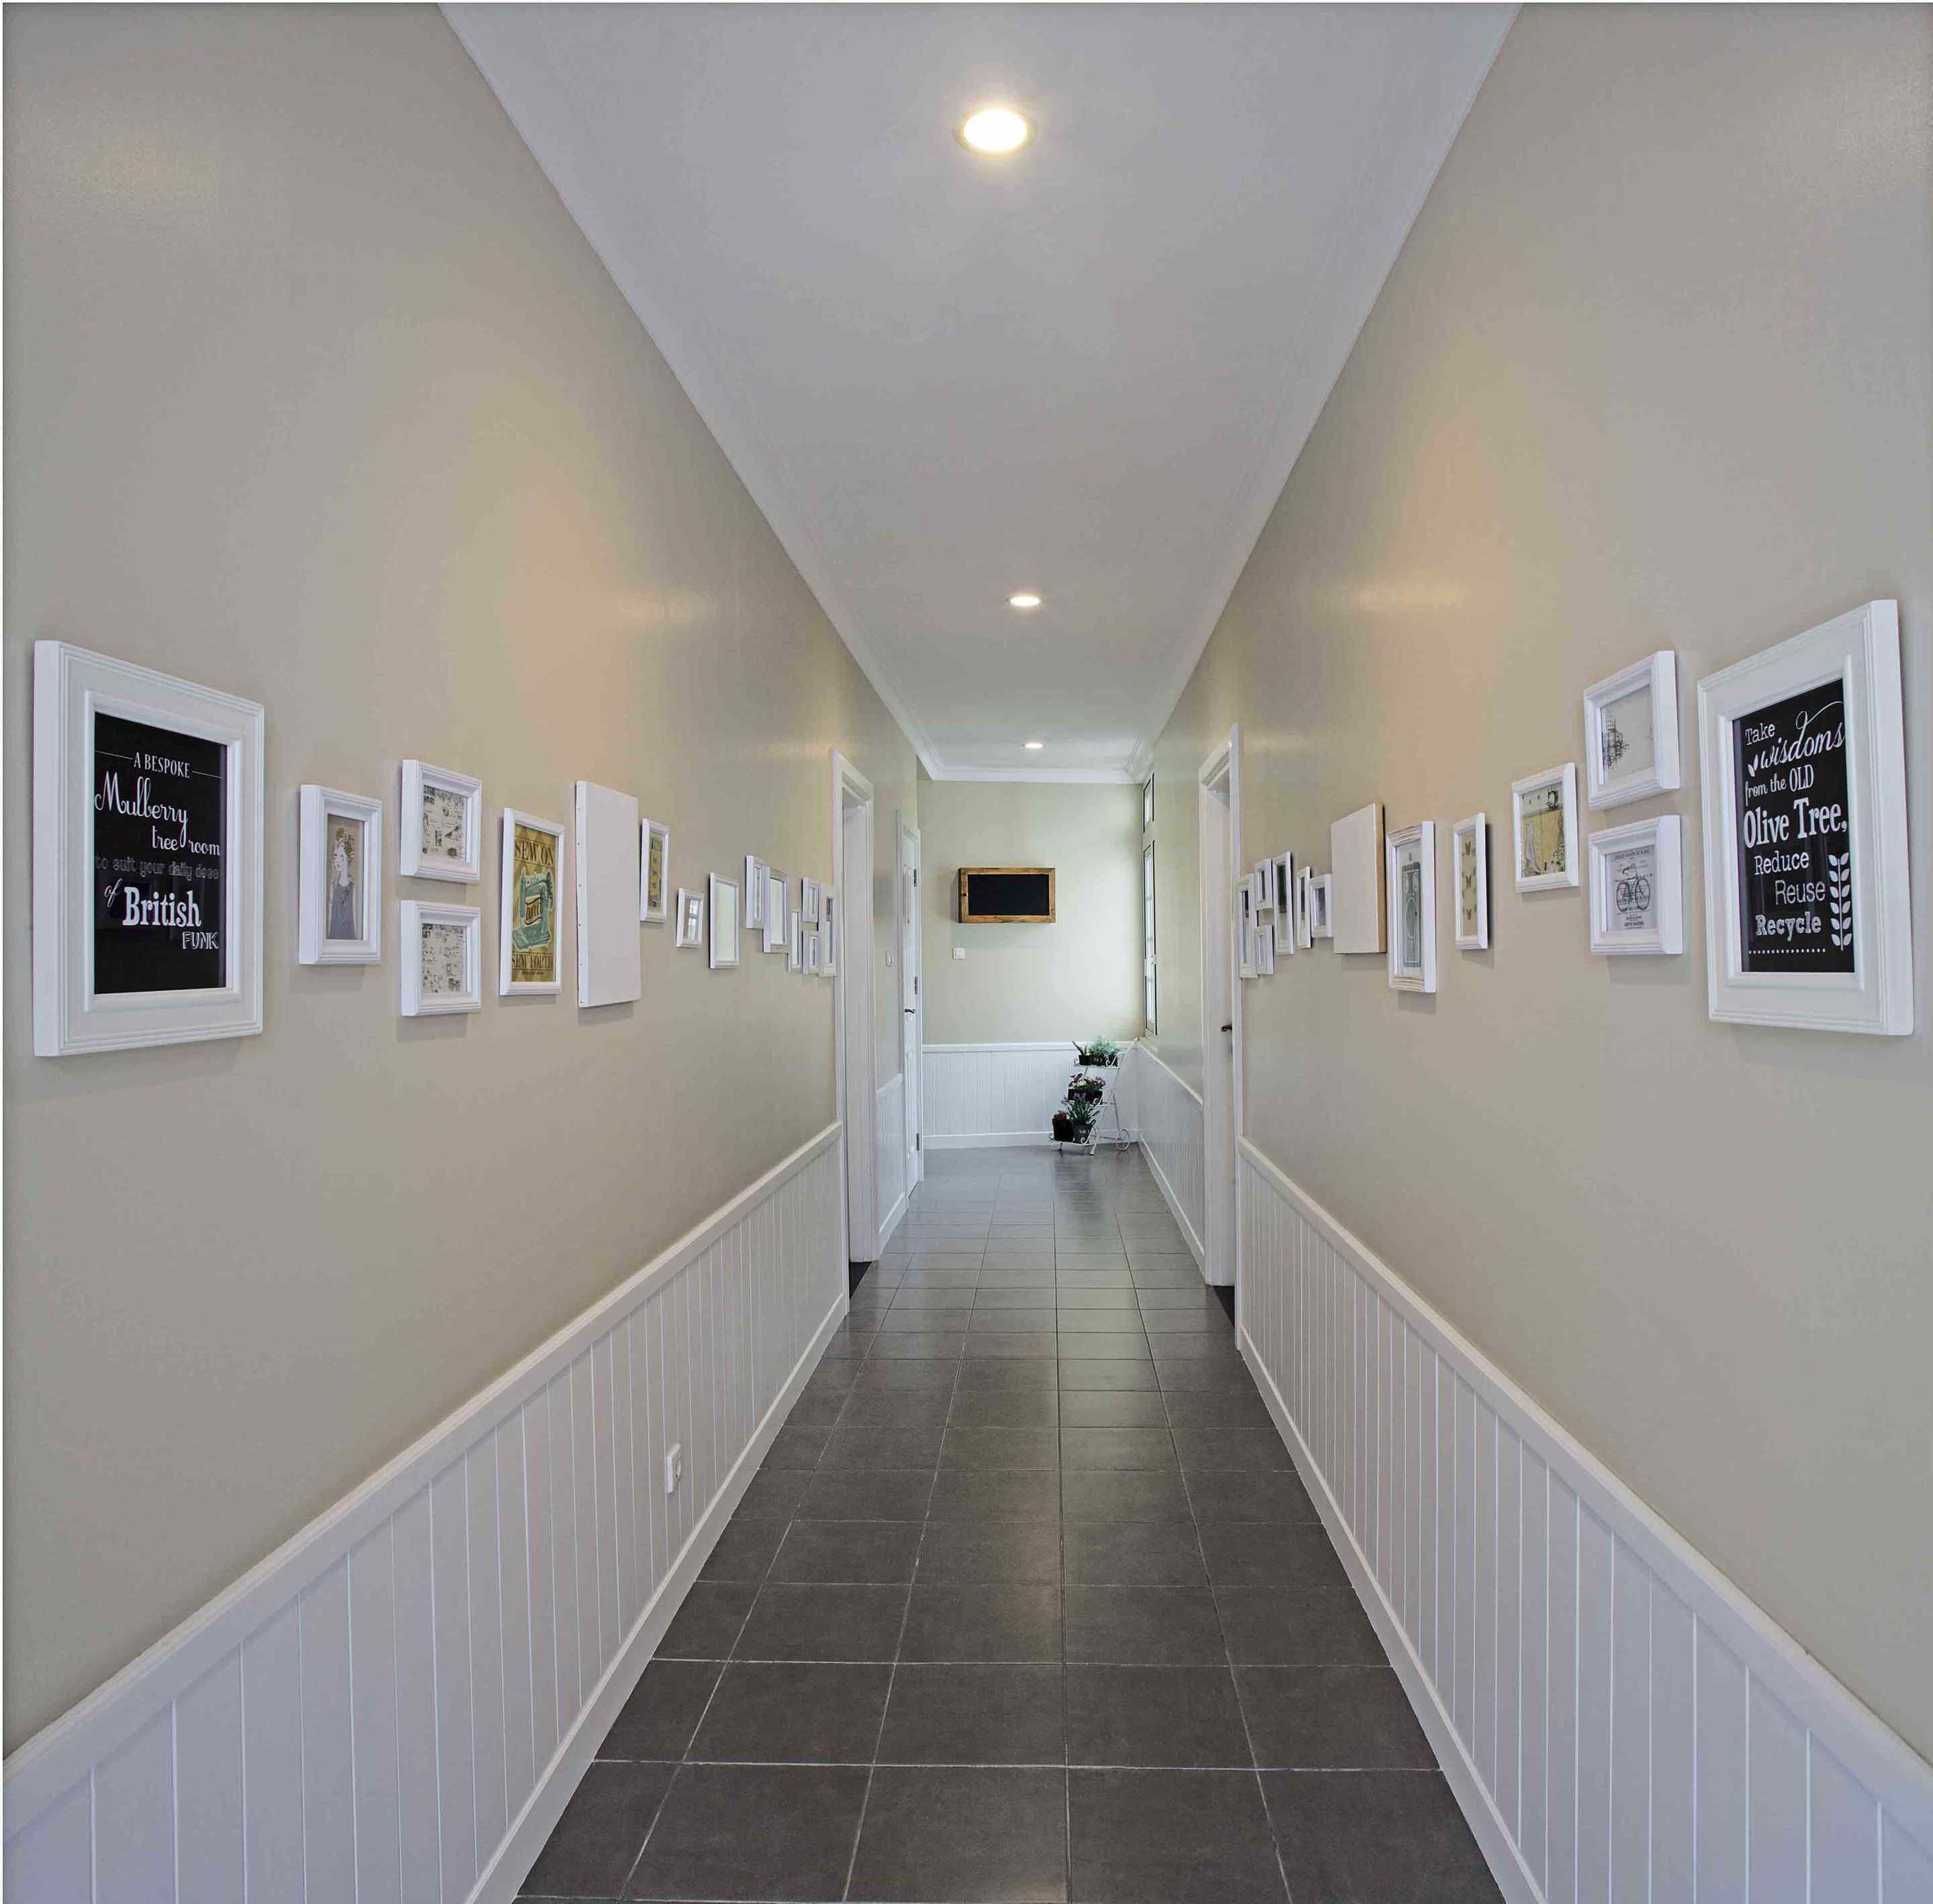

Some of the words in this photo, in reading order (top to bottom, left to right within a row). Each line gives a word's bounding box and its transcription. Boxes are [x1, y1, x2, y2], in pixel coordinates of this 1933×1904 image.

[1746, 723, 1775, 746] Take
[1760, 702, 1844, 769] wisdoms
[134, 752, 141, 768] A
[144, 753, 191, 779] BESPOKE
[1745, 781, 1768, 807] from
[1770, 773, 1787, 792] the
[1789, 764, 1814, 792] OLD
[95, 770, 189, 848] Mulberry
[1744, 806, 1789, 848] Olive
[1793, 798, 1847, 839] Tree,
[151, 825, 179, 850] tree
[189, 838, 221, 856] room
[1754, 851, 1810, 875] Reduce
[103, 878, 123, 907] of
[122, 887, 202, 928] British
[1775, 879, 1826, 905] Reuse
[182, 932, 219, 950] FUNK
[1755, 911, 1822, 941] Recycle
